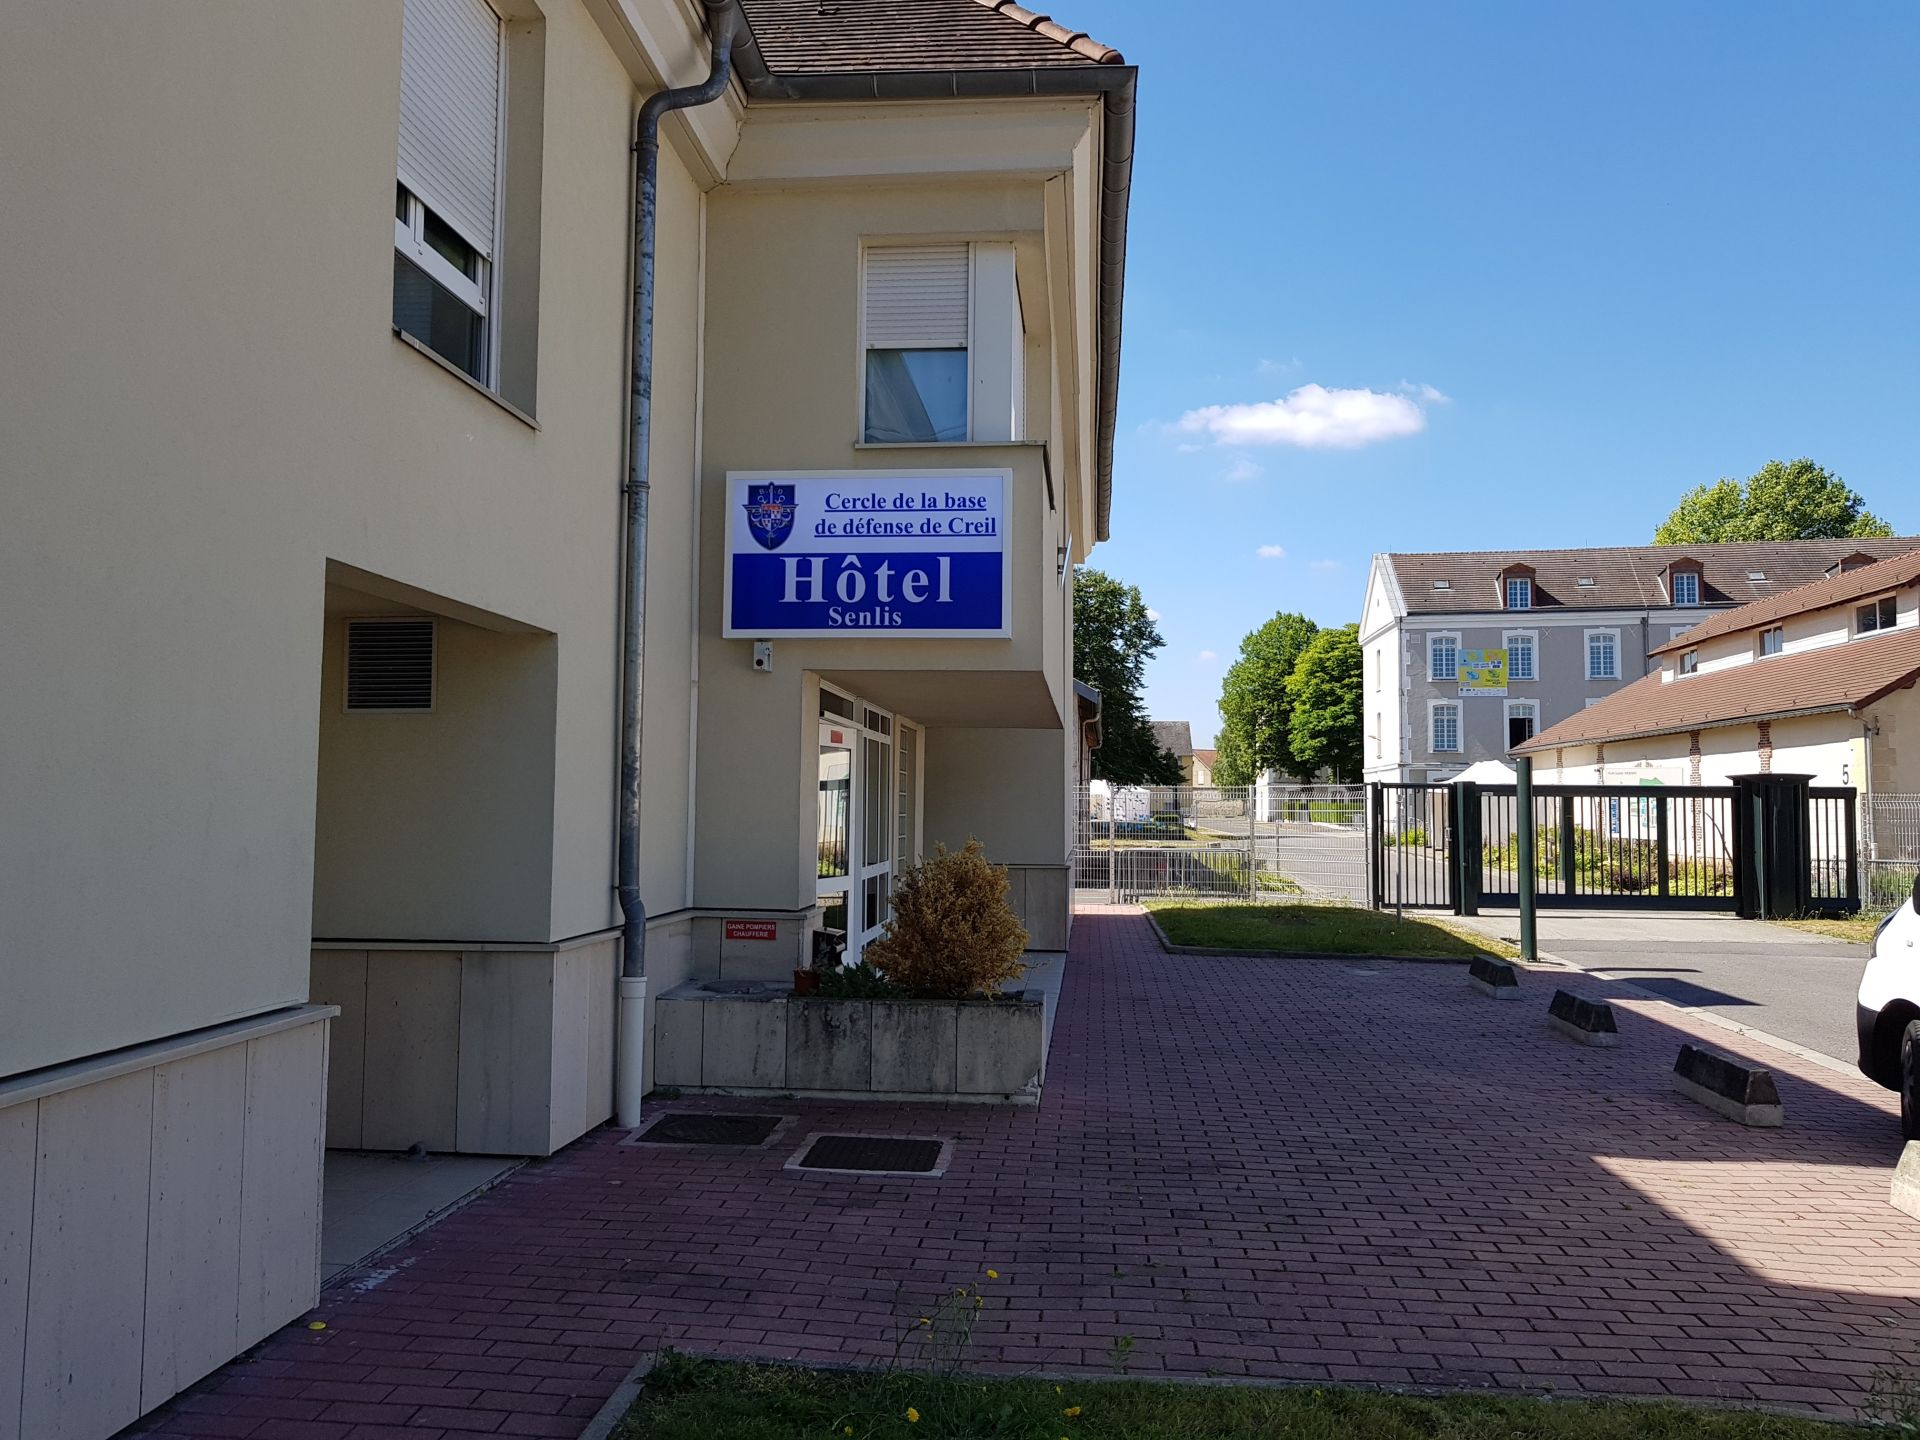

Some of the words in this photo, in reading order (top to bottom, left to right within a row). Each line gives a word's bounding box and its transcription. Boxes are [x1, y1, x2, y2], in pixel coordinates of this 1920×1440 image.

[825, 493, 886, 509] Cercle
[892, 493, 914, 509] de
[921, 493, 938, 508] la
[944, 492, 986, 508] base
[815, 519, 838, 535] de
[843, 518, 913, 534] défense
[920, 518, 942, 534] de
[949, 517, 996, 534] Creil
[778, 554, 953, 604] Hôtel
[828, 606, 902, 626] Senlis
[1842, 764, 1849, 785] 5
